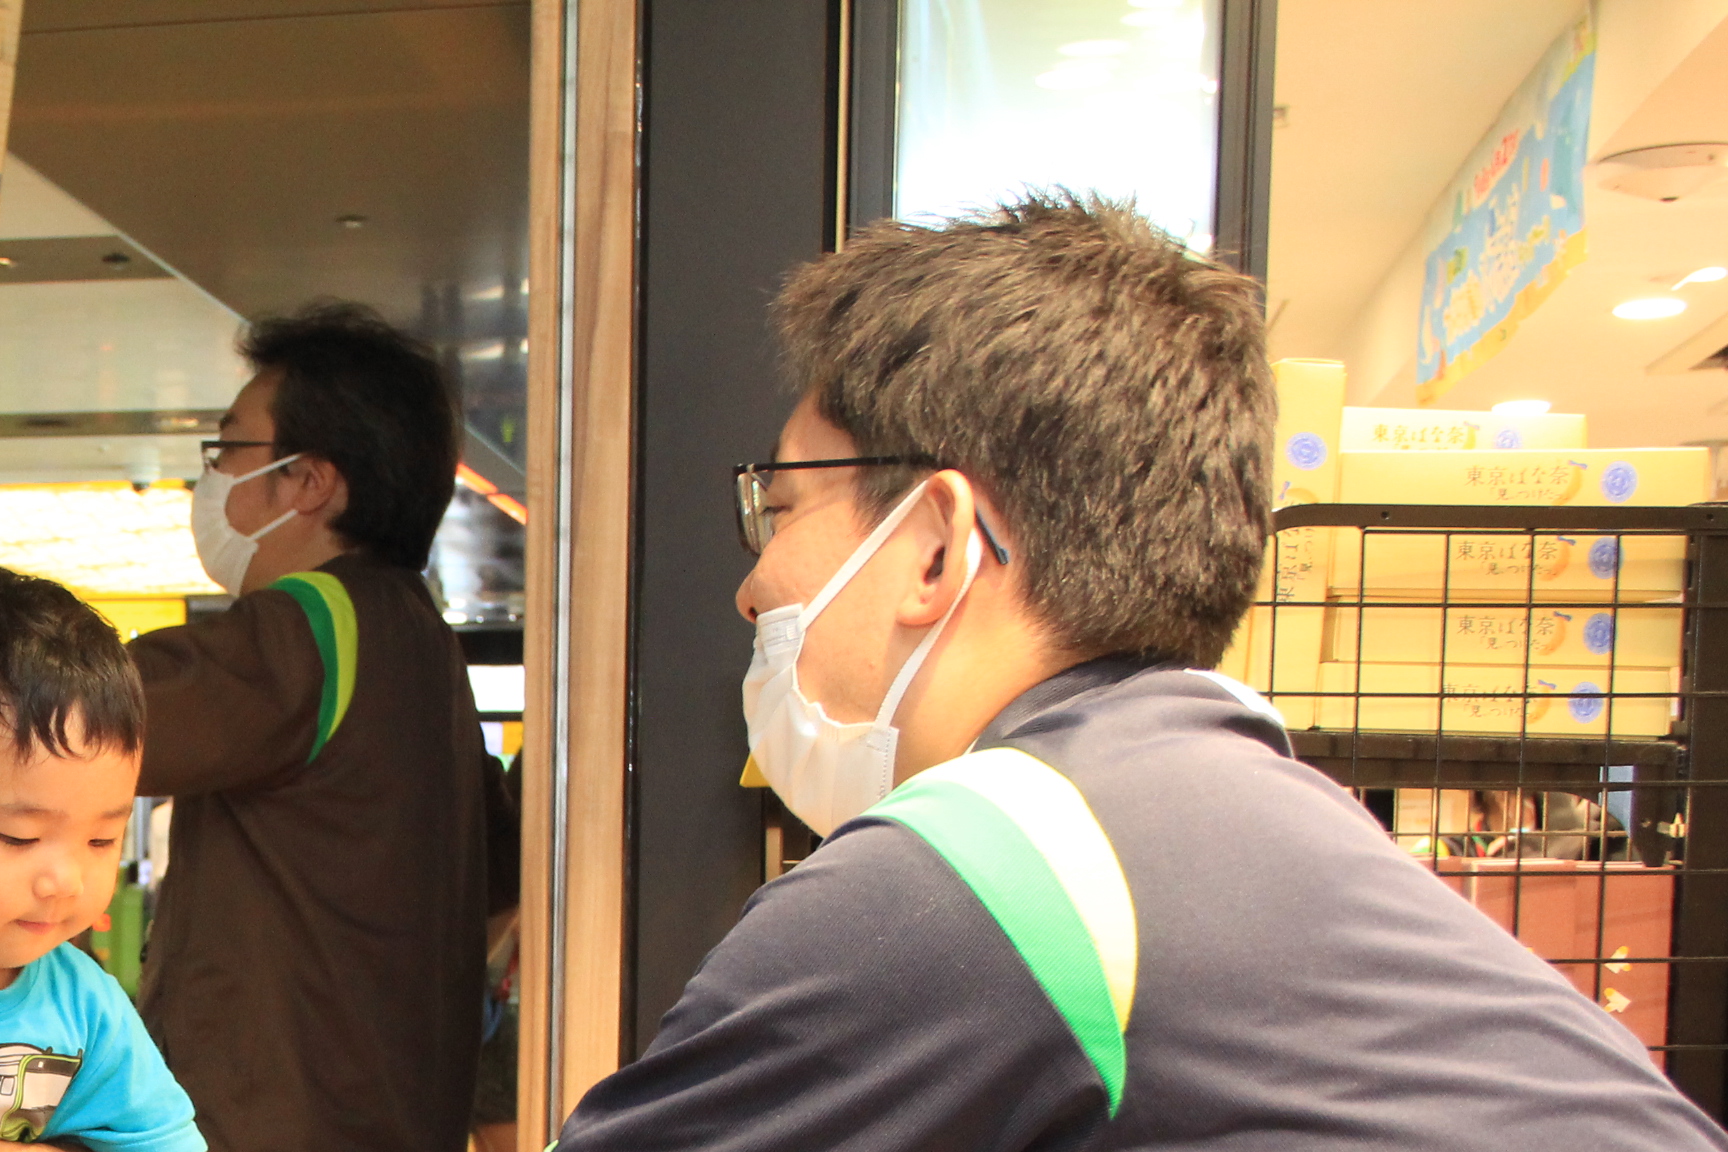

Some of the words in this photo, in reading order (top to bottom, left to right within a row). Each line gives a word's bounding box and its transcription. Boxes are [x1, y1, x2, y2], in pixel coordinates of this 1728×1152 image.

[1373, 424, 1464, 444] 東京ばな奈
[1465, 465, 1569, 486] 東京ばな奈
[1456, 541, 1558, 561] 東京ばな奈
[1457, 615, 1555, 635] 東京ばな奈
